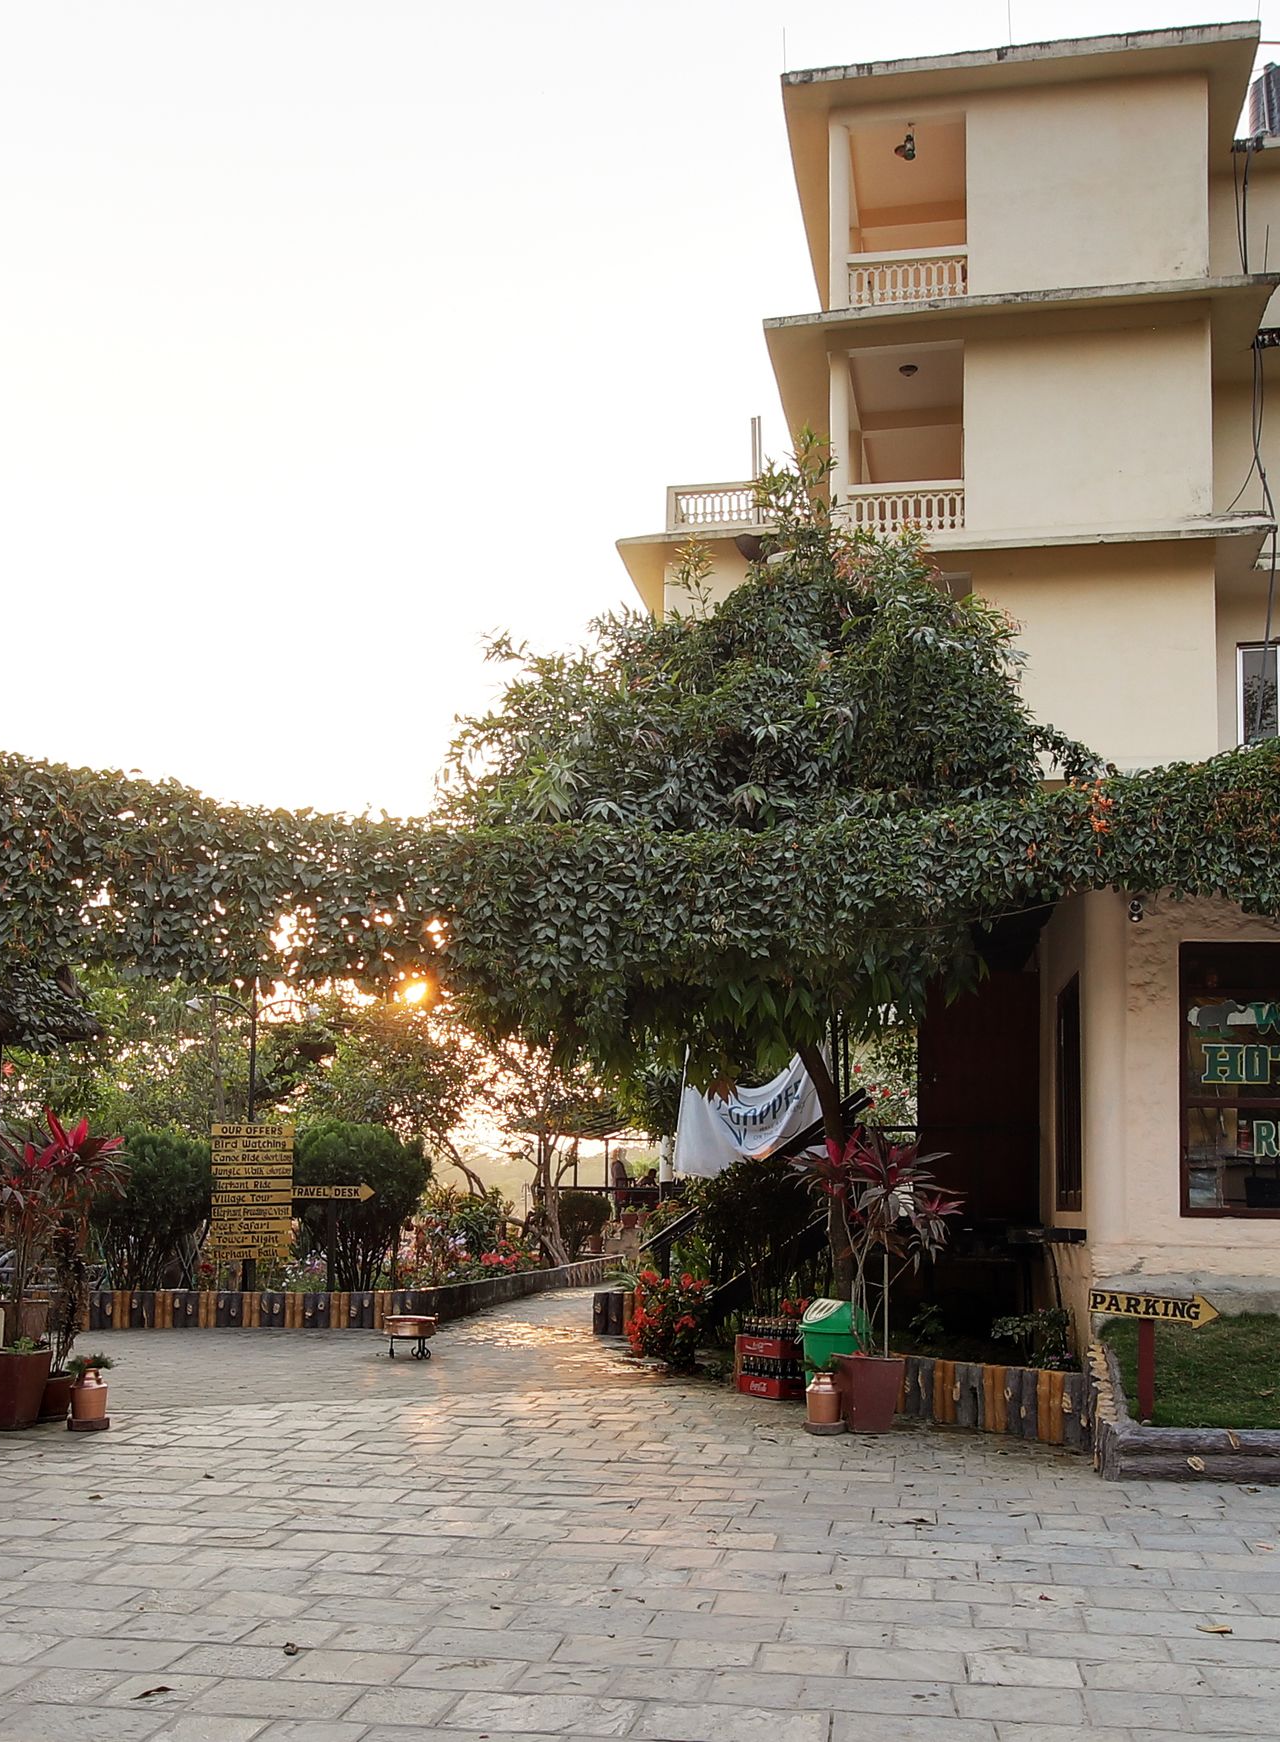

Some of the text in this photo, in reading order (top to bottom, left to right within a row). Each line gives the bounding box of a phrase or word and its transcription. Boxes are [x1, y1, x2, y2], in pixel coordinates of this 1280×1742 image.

[221, 1126, 283, 1136] OUR OFFERS
[242, 1140, 287, 1150] Watching
[213, 1153, 239, 1162] Canoe
[241, 1153, 260, 1162] Ride
[212, 1166, 241, 1176] Jungle
[244, 1166, 265, 1176] Walk
[253, 1180, 272, 1189] Ride
[292, 1187, 360, 1197] TRAVEL DESK
[213, 1193, 273, 1204] Village Tour
[212, 1221, 270, 1232] Jeep Safari
[216, 1235, 279, 1246] Tower Night
[213, 1249, 252, 1260] Elephant
[1091, 1293, 1200, 1320] PARKING
